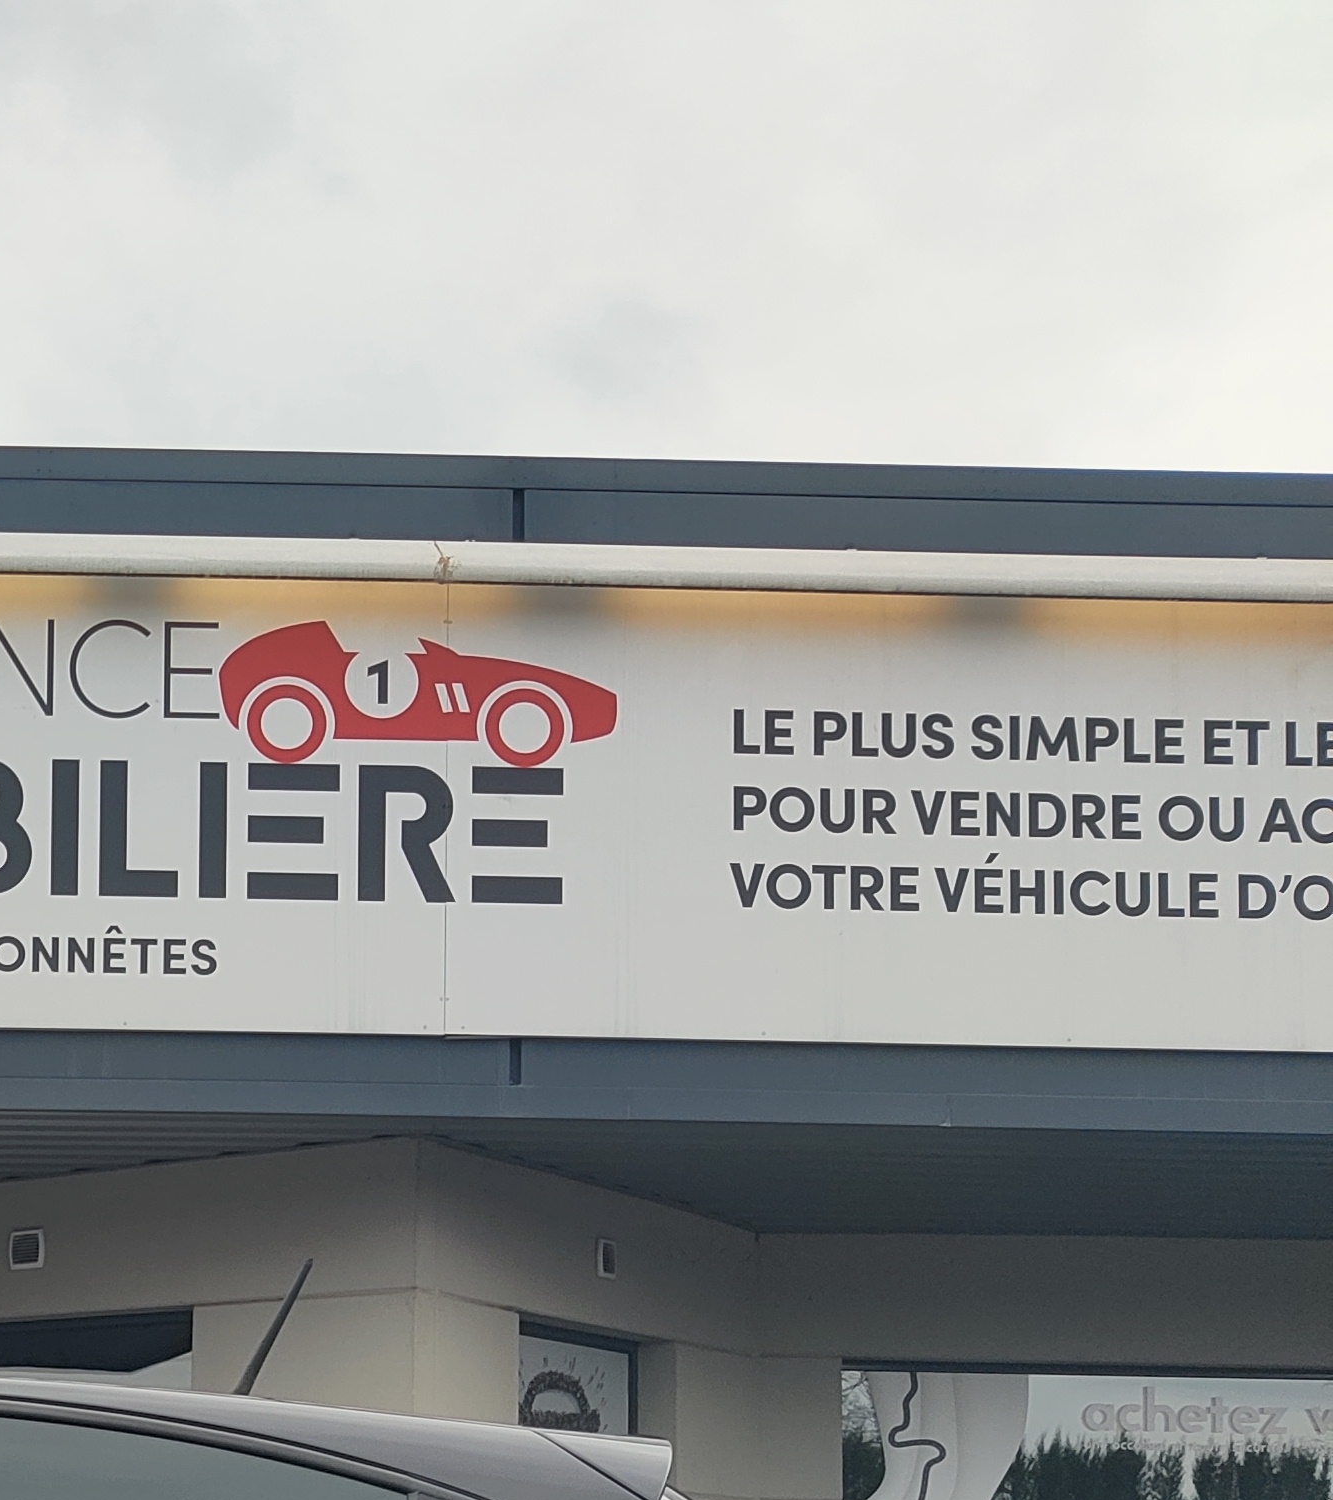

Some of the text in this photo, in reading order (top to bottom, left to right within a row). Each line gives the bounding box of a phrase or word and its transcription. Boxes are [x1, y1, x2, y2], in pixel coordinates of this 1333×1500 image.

[366, 659, 390, 705] 1
[733, 708, 795, 755] LE
[813, 710, 955, 760] PLUS
[970, 714, 1185, 765] SIMPLE
[1204, 719, 1270, 766] ET
[733, 786, 897, 836] POUR
[910, 790, 1142, 840] VENDRE
[1158, 795, 1245, 842] OU
[730, 863, 920, 912] VOTRE
[934, 852, 1220, 919] VÉHICULE
[1081, 1386, 1287, 1434] achetez
